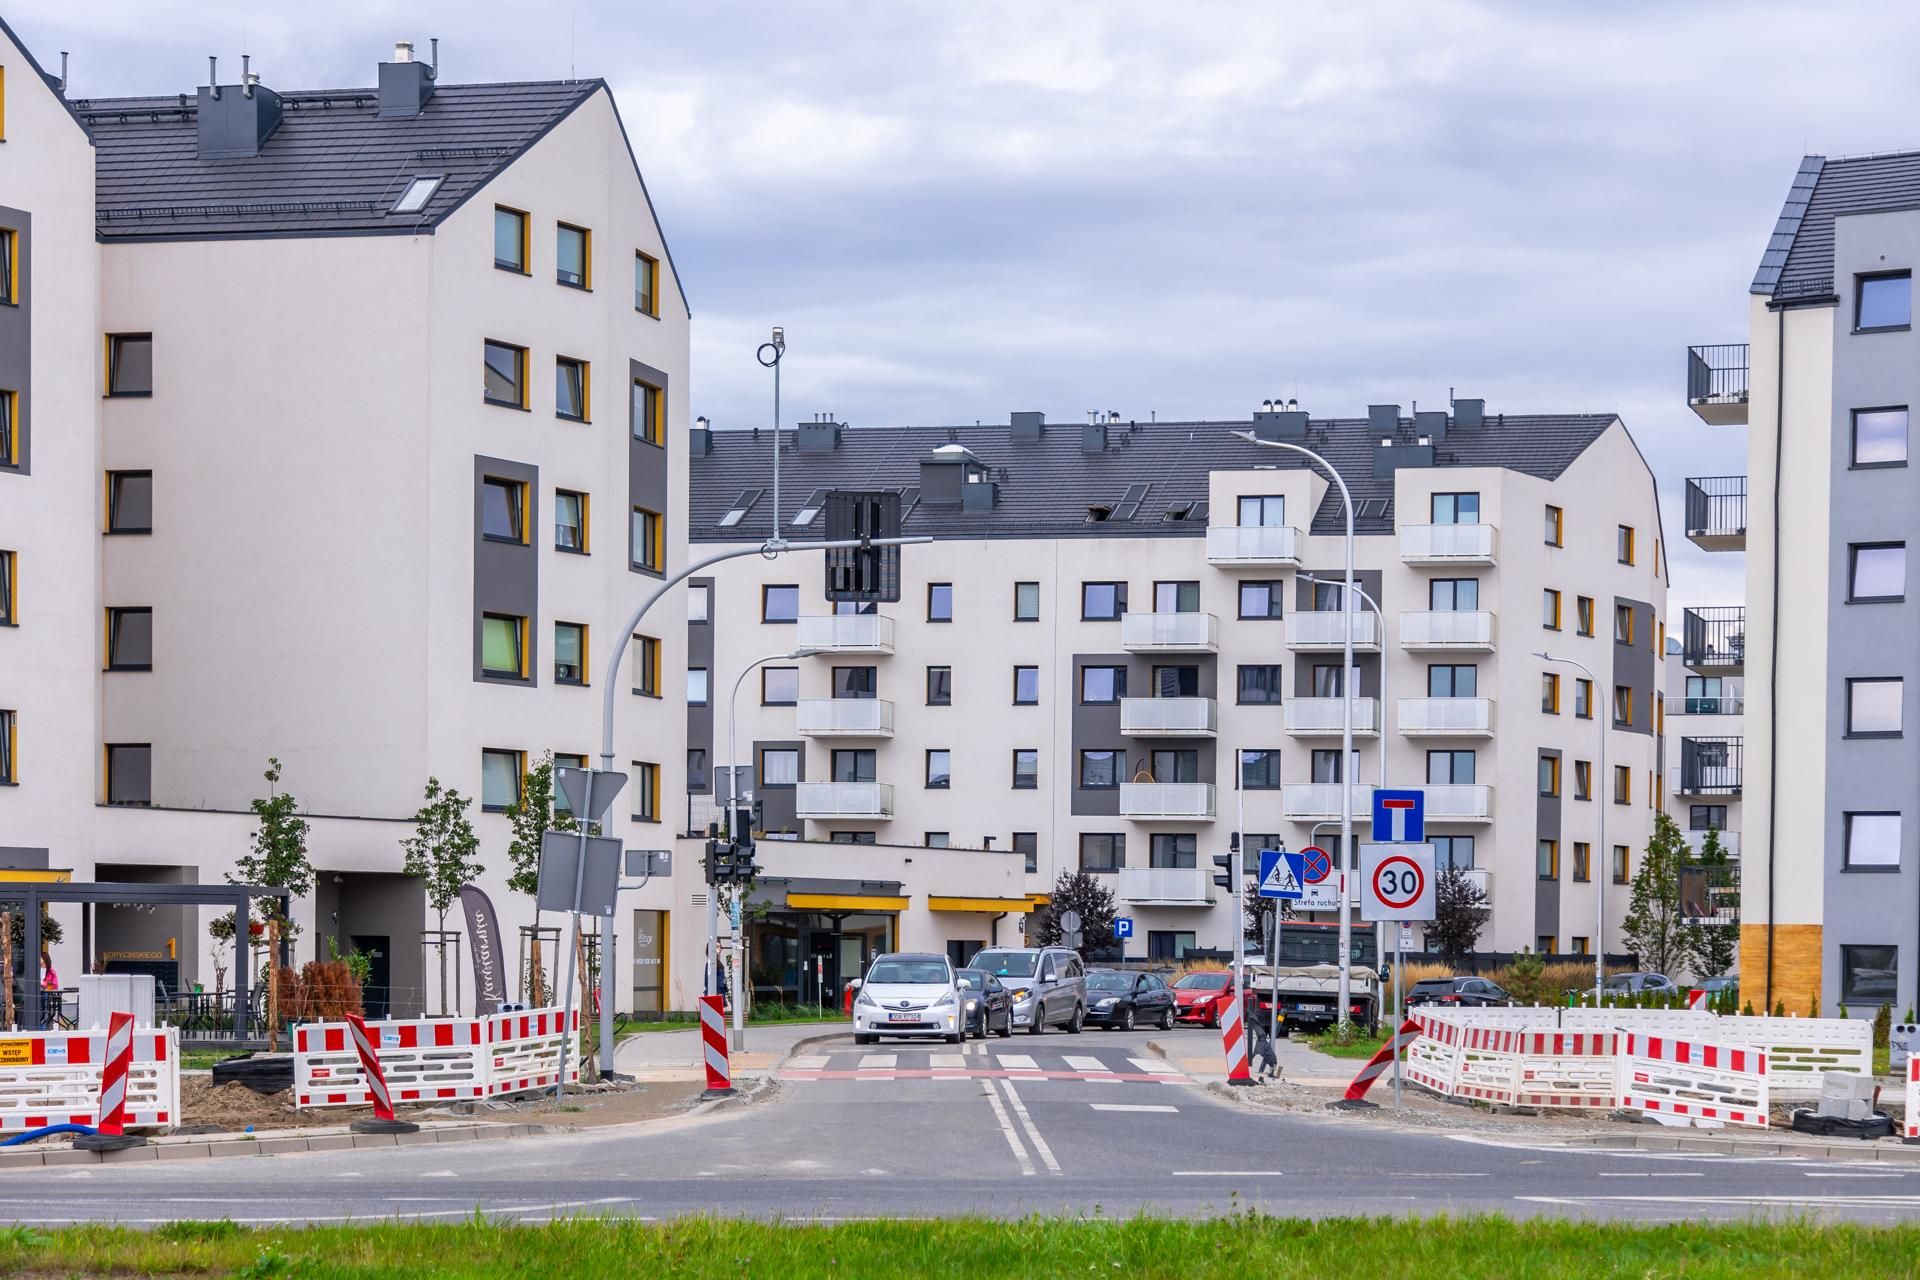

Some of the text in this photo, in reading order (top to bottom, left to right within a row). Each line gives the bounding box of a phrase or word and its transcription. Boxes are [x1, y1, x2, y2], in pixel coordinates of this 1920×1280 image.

[1382, 870, 1416, 895] 30
[1317, 899, 1337, 907] ruchu
[1118, 920, 1129, 935] P
[166, 936, 177, 960] 1
[3, 1049, 21, 1057] WSTĘP
